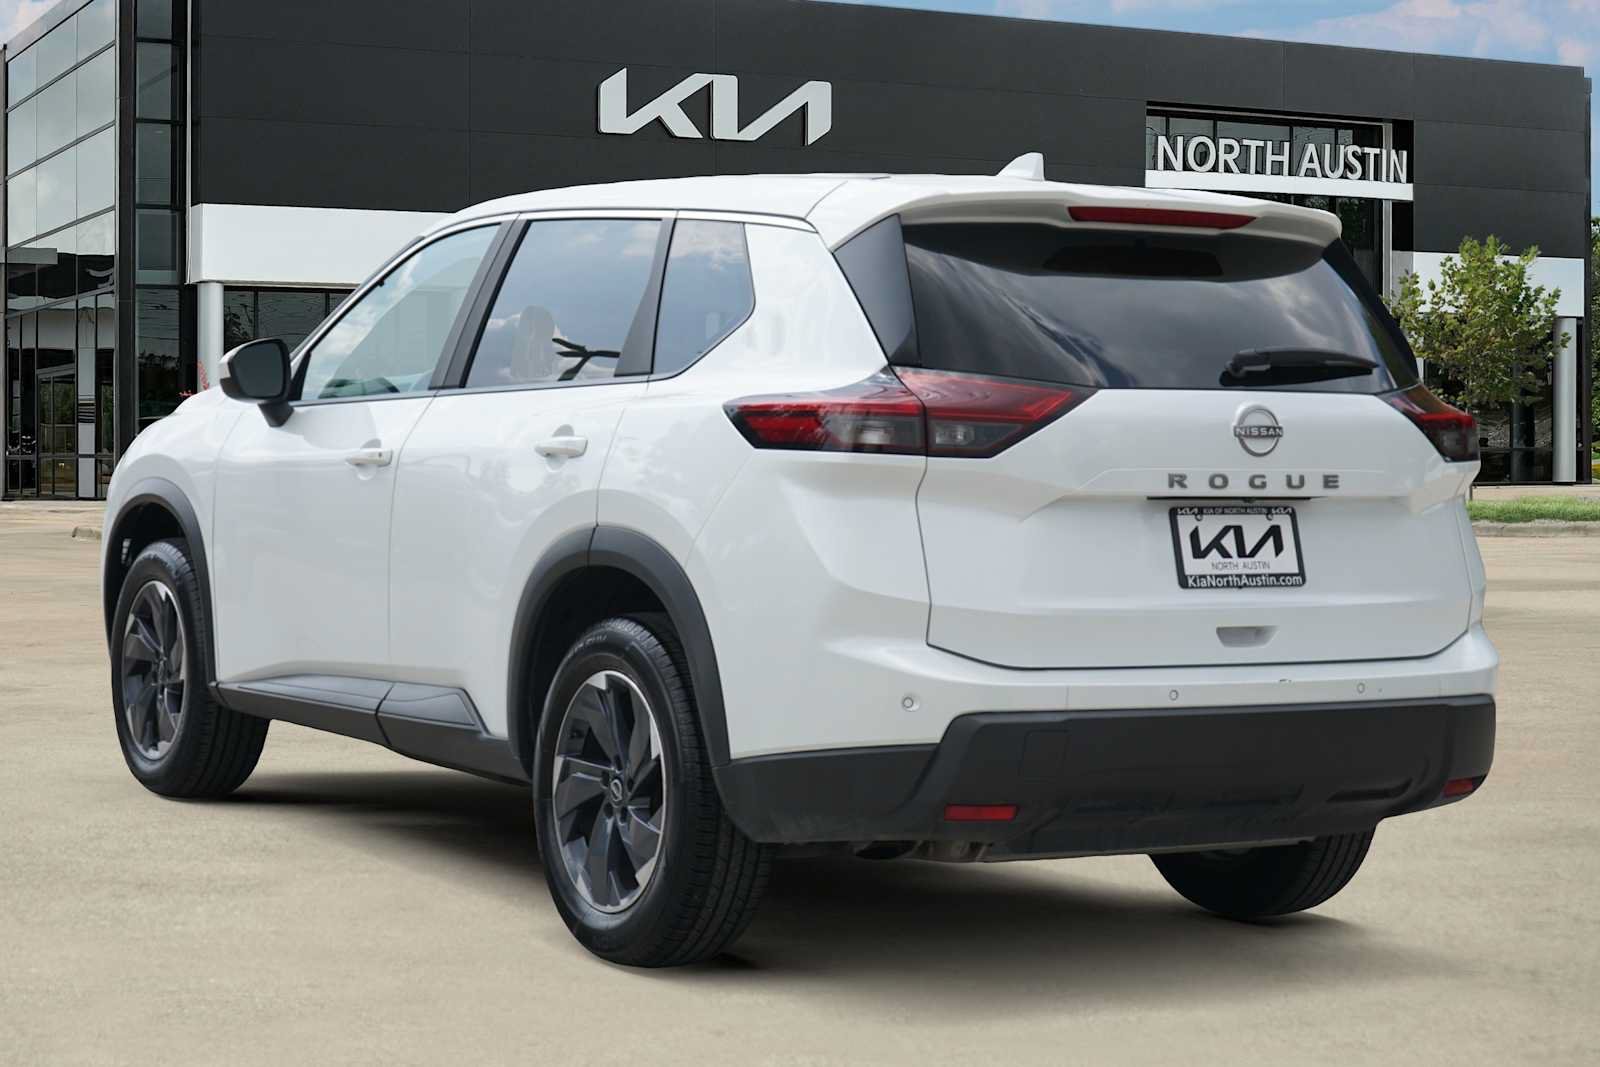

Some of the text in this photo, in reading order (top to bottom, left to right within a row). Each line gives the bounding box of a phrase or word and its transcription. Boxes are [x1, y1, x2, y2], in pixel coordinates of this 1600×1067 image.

[598, 67, 832, 146] KIA
[1156, 135, 1408, 184] NORTH AUSTIN
[1236, 427, 1283, 437] NISSAN
[1167, 473, 1340, 489] ROGUE
[1189, 525, 1284, 559] KIA
[1211, 560, 1271, 571] NORTH AUSTIN
[1187, 573, 1303, 588] KiaNorthAustin.com
